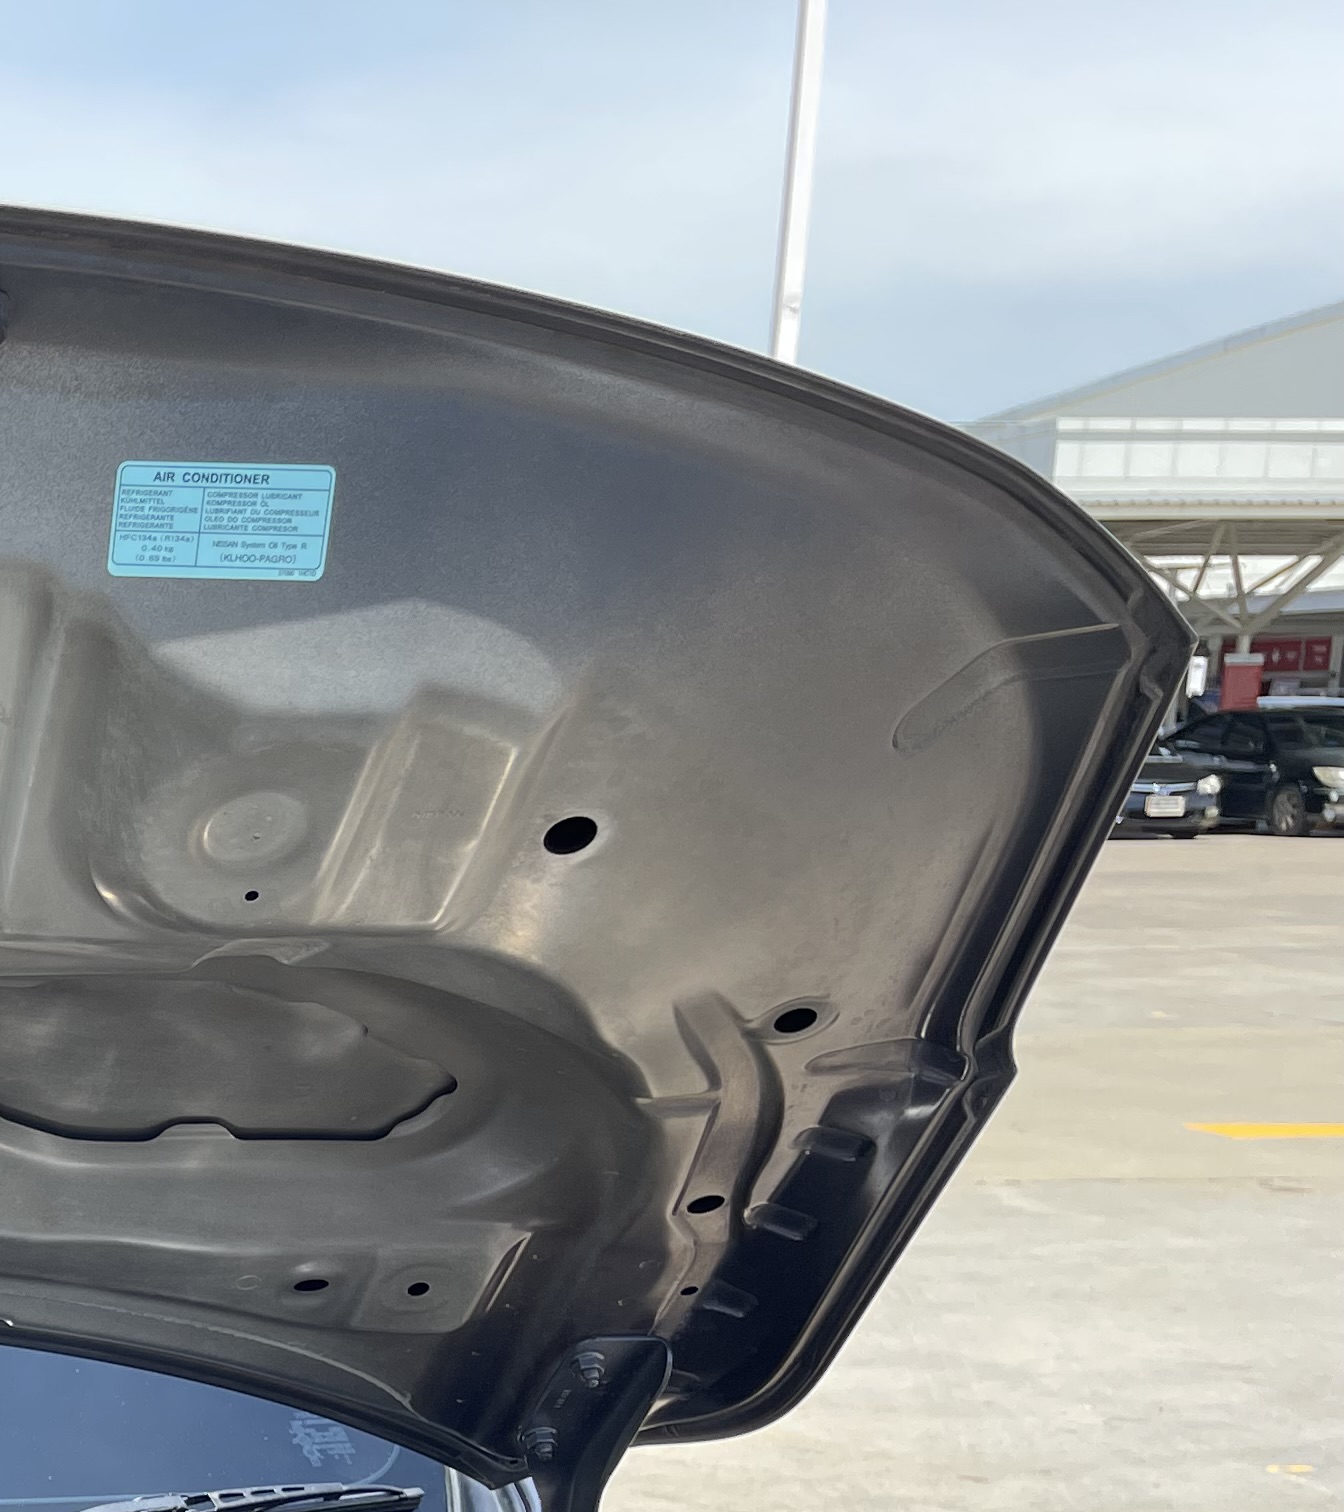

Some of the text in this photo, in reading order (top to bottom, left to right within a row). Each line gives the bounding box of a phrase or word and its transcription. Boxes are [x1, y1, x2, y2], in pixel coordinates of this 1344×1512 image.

[153, 471, 270, 485] AIR CONDITIONER
[121, 488, 173, 497] REFRIGERANT
[207, 491, 303, 500] COMPRESSOR LUBRICANT
[206, 499, 257, 507] KOMPRESSOR
[119, 505, 146, 513] FLUIDE
[205, 507, 320, 517] LUBRIFIANT DU COMPRESSEUR
[119, 513, 174, 521] REFRIGERANTE
[240, 516, 293, 524] COMPRESSOR
[118, 521, 173, 529] REFRIGERANTE
[119, 533, 157, 541] HFC134a
[281, 541, 297, 551] Type
